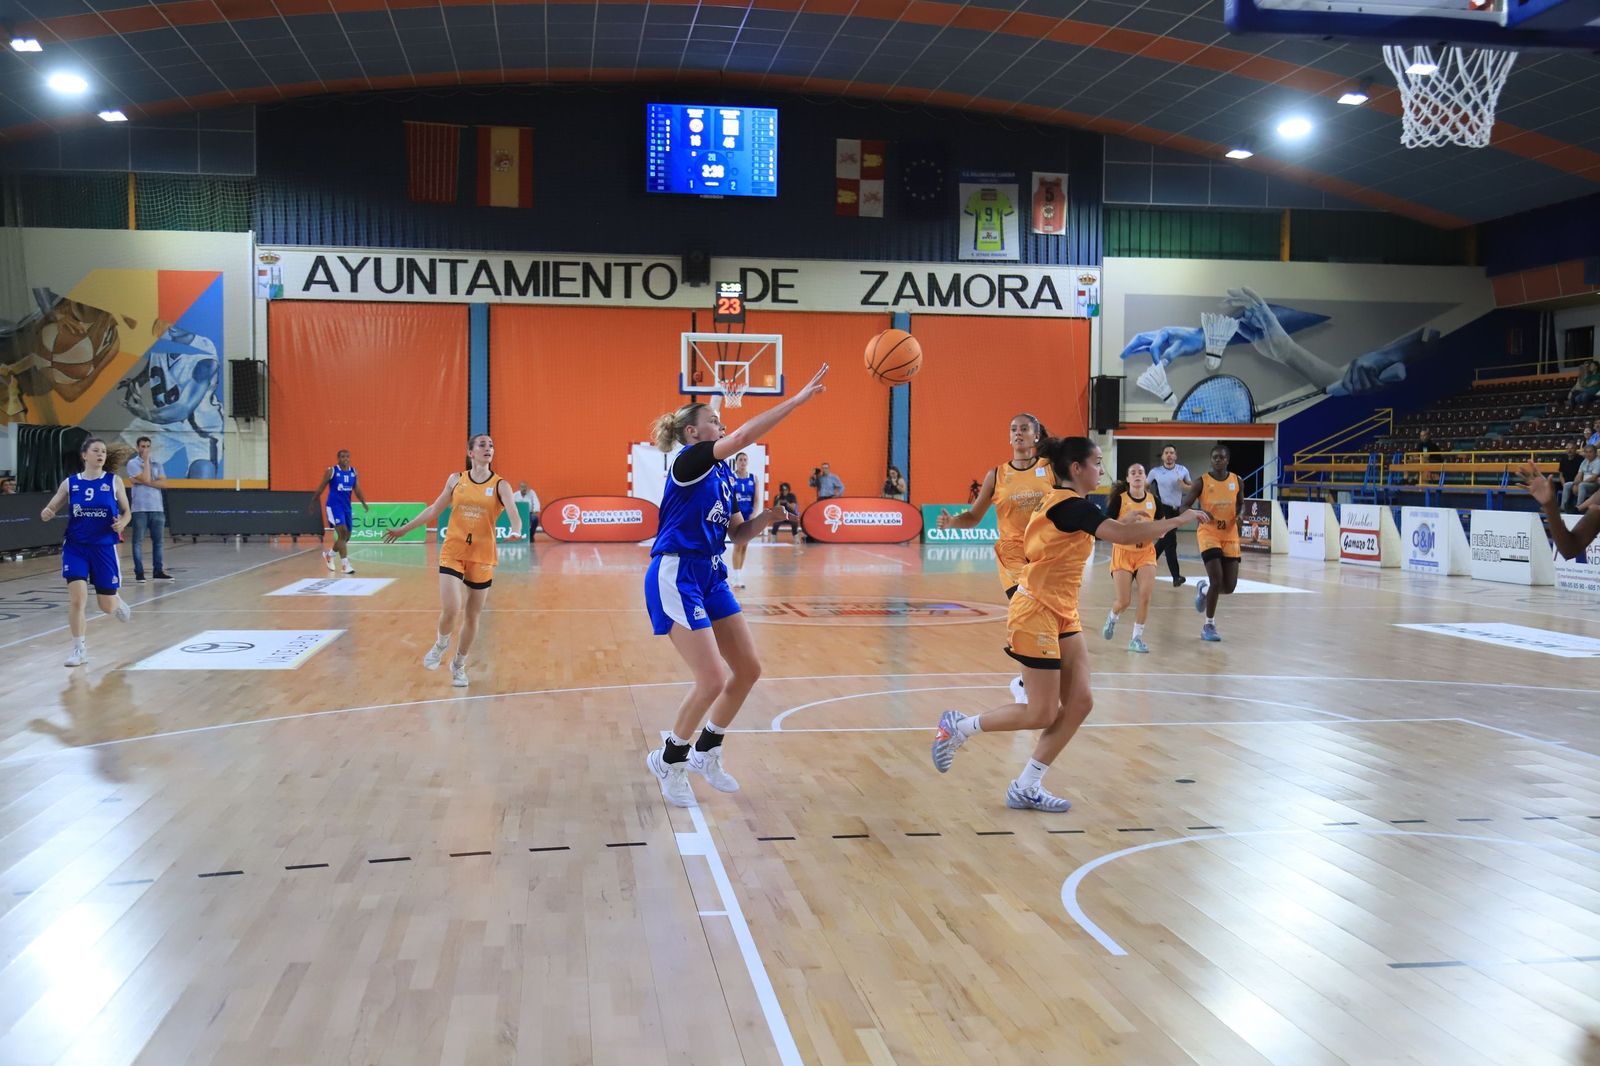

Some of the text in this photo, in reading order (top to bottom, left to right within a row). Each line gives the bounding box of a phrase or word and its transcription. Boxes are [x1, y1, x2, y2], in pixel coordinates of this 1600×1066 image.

[985, 207, 993, 222] 9
[302, 255, 1063, 310] AYUNTAMIENTO DE ZAMORA
[718, 298, 741, 314] 23
[85, 487, 94, 501] 9
[1217, 520, 1226, 530] 23
[351, 530, 383, 538] CASH
[465, 533, 473, 546] 4
[927, 528, 999, 541] CAJA RURA
[1472, 530, 1530, 550] RESTAURANTE
[1366, 538, 1375, 550] 22
